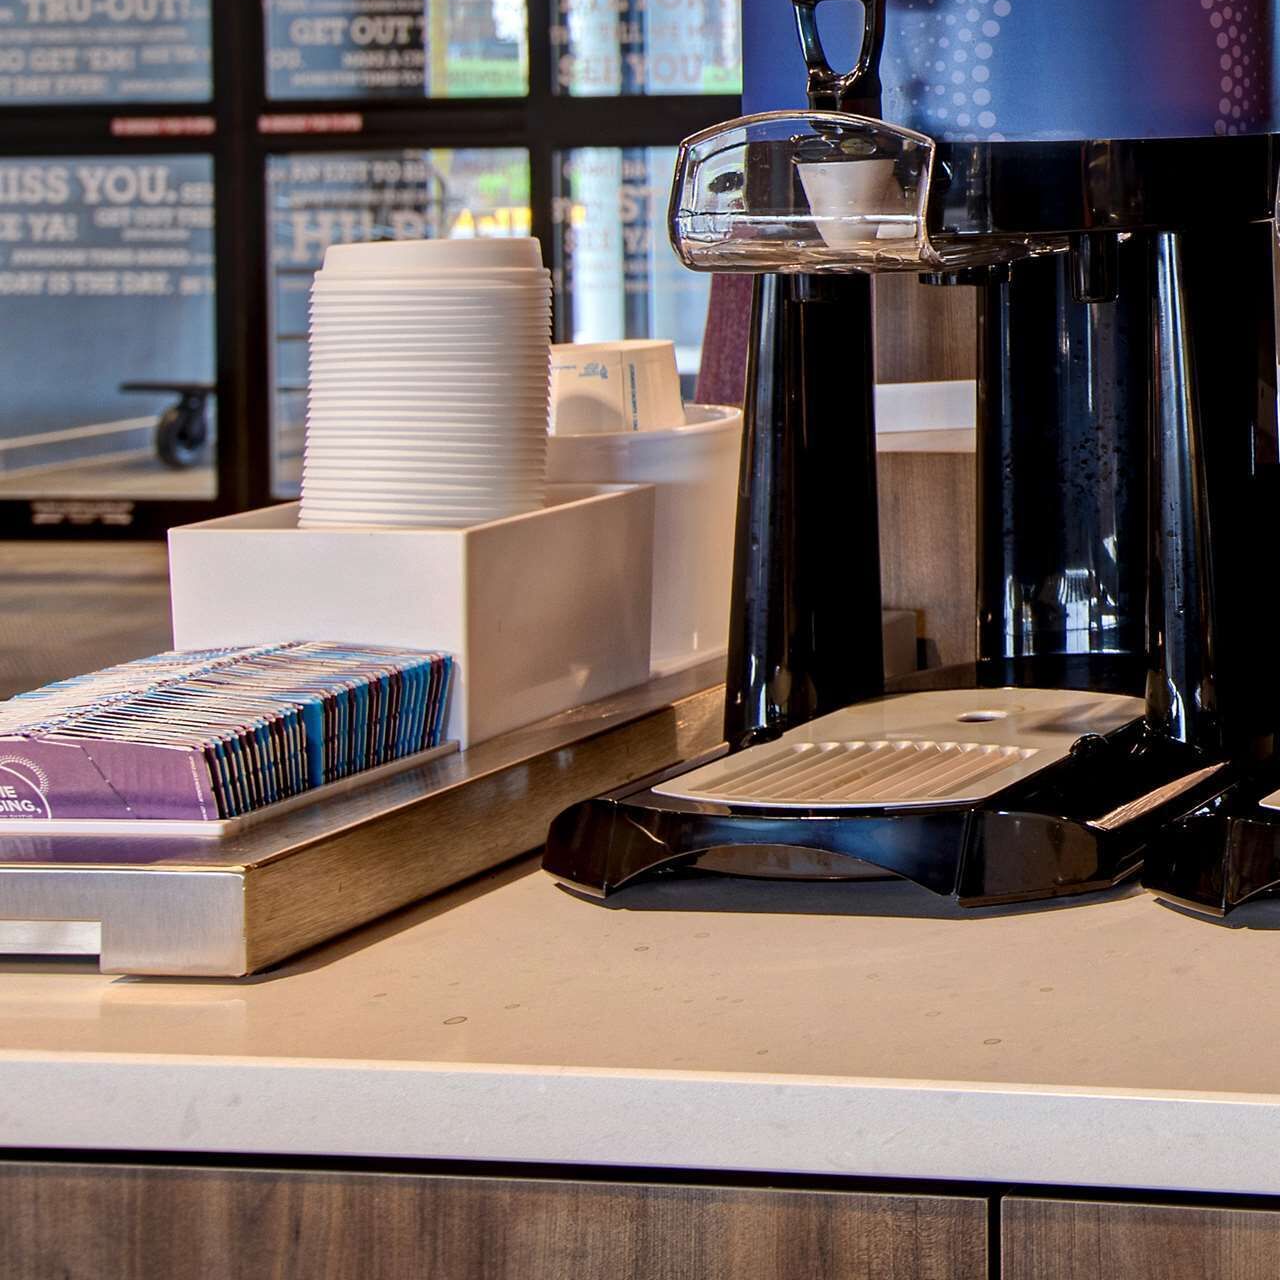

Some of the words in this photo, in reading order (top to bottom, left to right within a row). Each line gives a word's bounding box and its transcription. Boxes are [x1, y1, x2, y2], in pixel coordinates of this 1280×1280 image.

[290, 18, 347, 45] GET
[351, 17, 413, 44] OUT
[76, 166, 177, 206] YOU.
